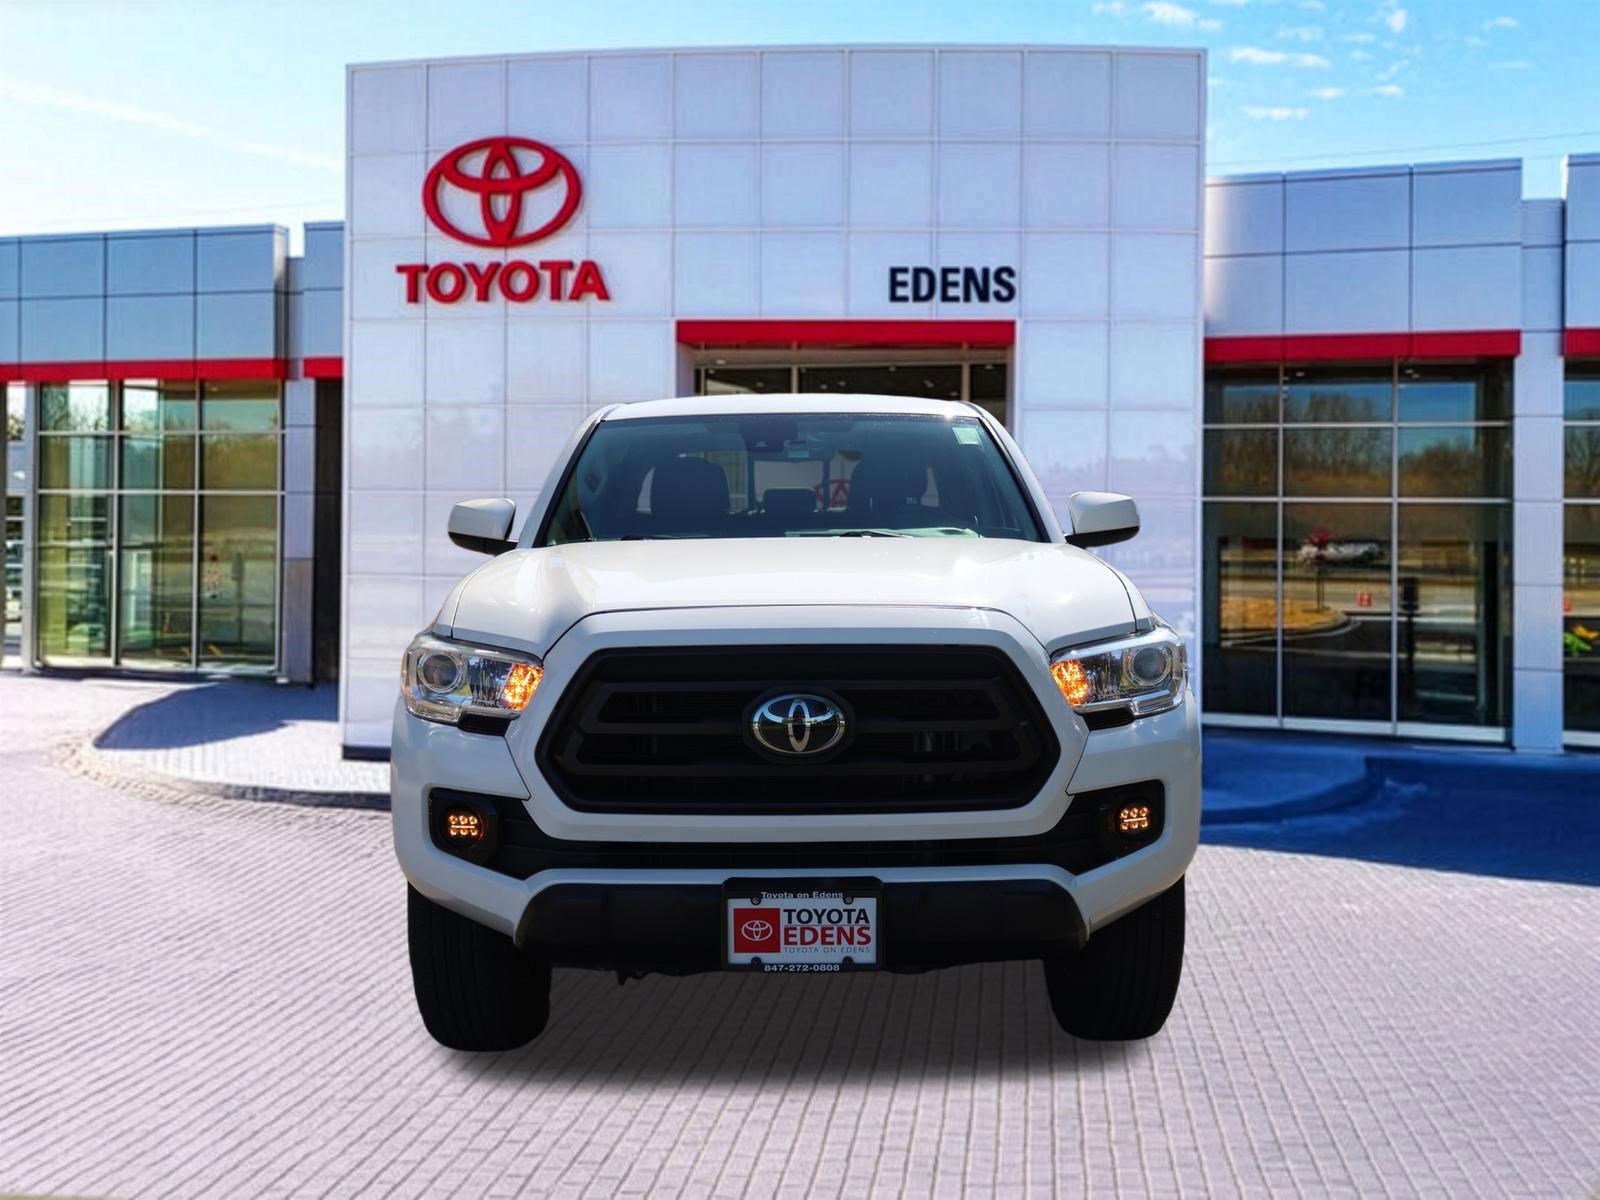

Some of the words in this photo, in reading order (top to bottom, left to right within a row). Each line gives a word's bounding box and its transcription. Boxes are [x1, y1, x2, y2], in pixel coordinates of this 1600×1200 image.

[396, 260, 611, 304] TOYOTA
[889, 266, 1017, 304] EDENS
[761, 891, 794, 900] Toyota
[812, 891, 844, 899] Edens
[783, 908, 870, 924] TOYOTA
[783, 926, 872, 946] EDENS
[764, 964, 840, 972] 847-272-0808
